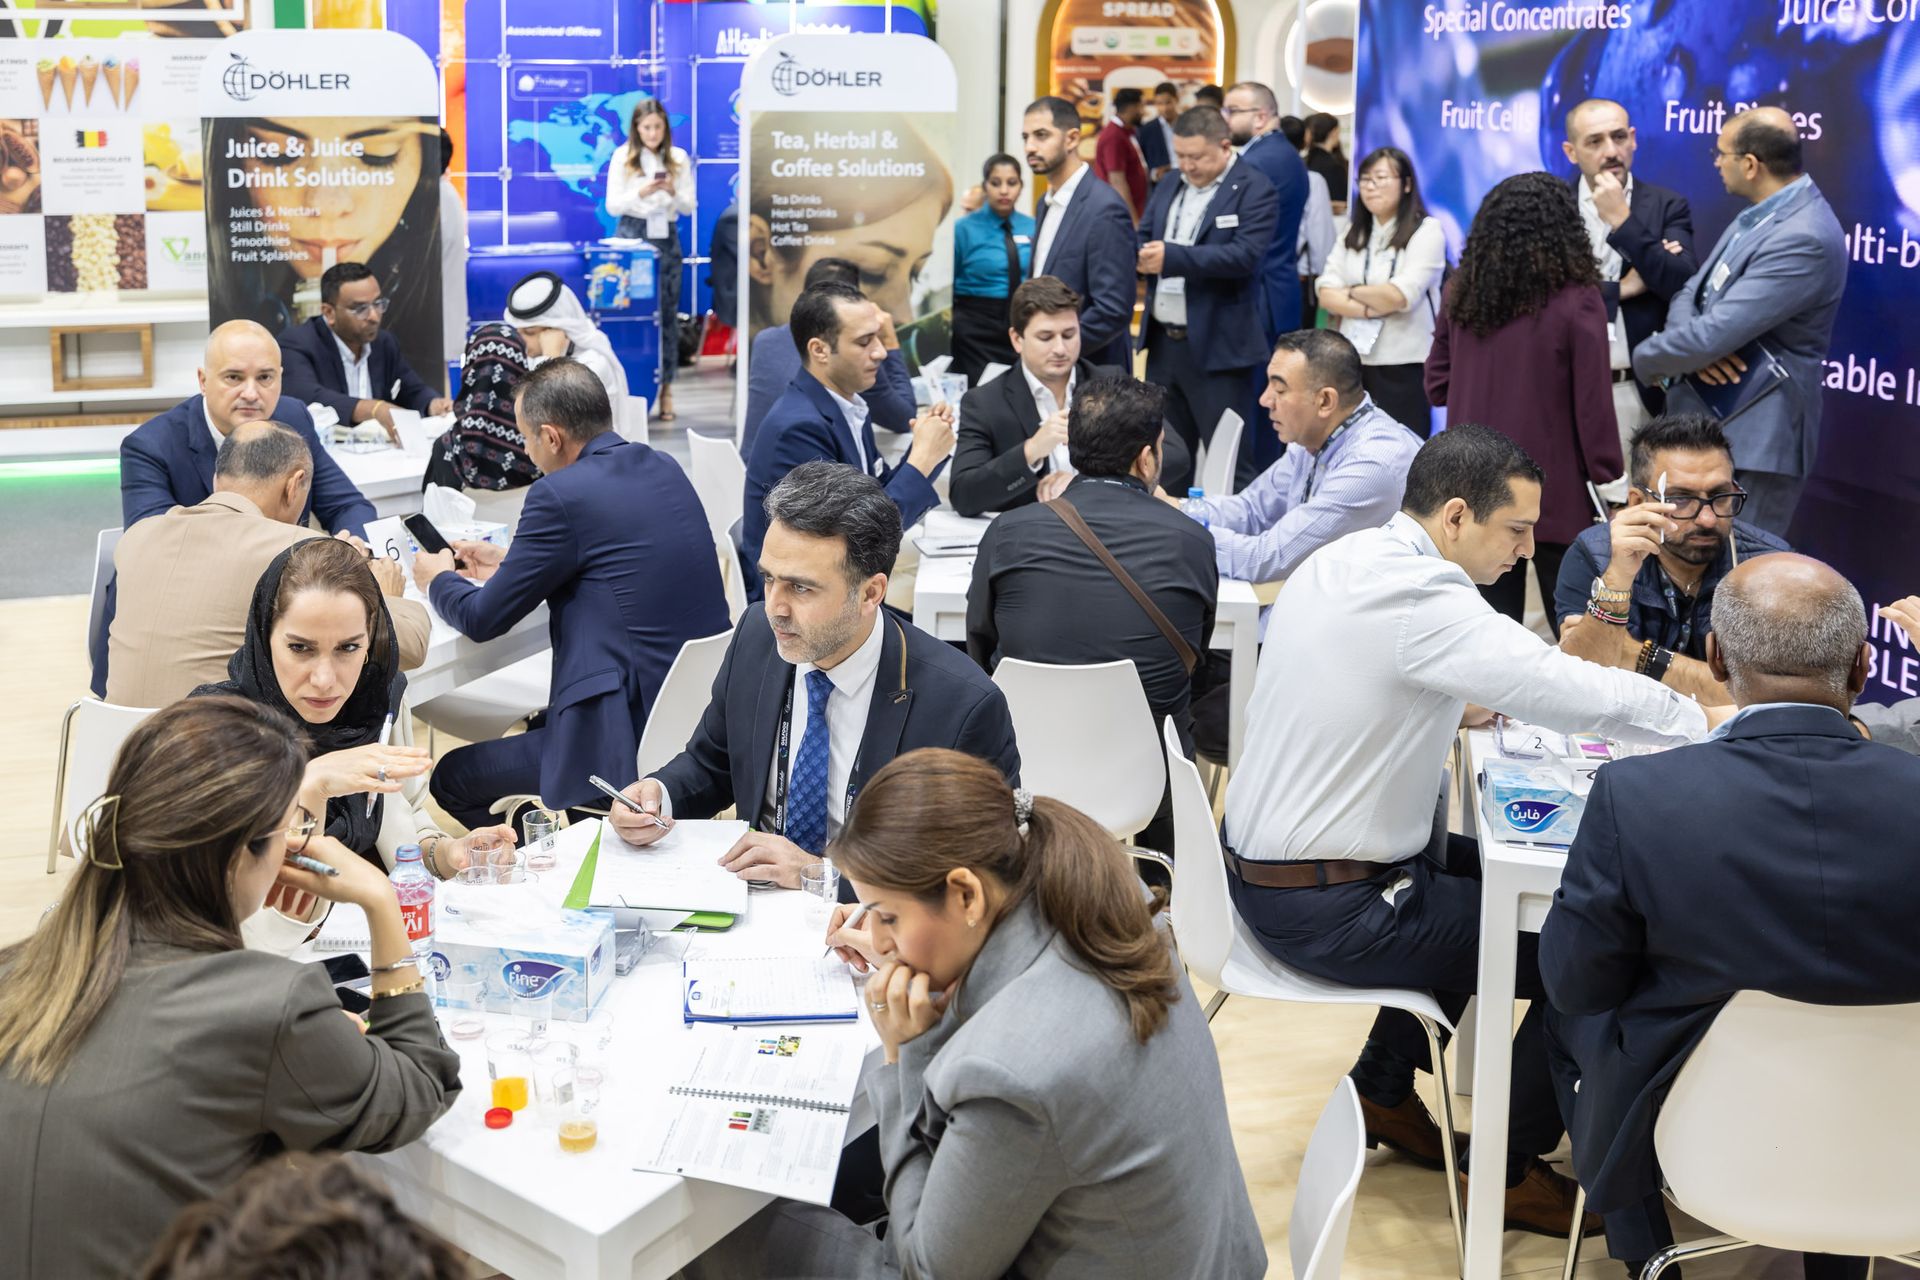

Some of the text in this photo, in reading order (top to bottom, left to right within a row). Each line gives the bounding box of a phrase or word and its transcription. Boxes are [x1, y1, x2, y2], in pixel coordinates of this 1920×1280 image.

[1103, 3, 1175, 17] SPREAD
[1778, 0, 1856, 25] Juice
[1424, 2, 1632, 40] Special Concentrates
[251, 70, 350, 90] DÖHLER
[796, 68, 882, 87] DÖHLER
[1441, 100, 1535, 132] Fruit Cells
[1664, 100, 1727, 134] Fruit
[225, 136, 364, 159] Juice & Juice
[771, 130, 898, 152] Tea, Herbal &
[771, 158, 925, 177] Coffee Solutions
[228, 167, 395, 188] Drink Solutions
[771, 194, 822, 205] Tea Drinks
[229, 205, 320, 218] Juices & Nectars
[771, 208, 837, 219] Herbal Drinks
[230, 220, 290, 232] Still Drinks
[771, 221, 808, 232] Hot Tea
[230, 235, 291, 248] Smoothies
[771, 235, 836, 246] Coffee Drinks
[231, 249, 309, 264] Fruit Splashes
[386, 538, 400, 560] 6
[1534, 736, 1542, 749] 2
[1510, 804, 1541, 822] فاين
[509, 965, 540, 988] Fine
